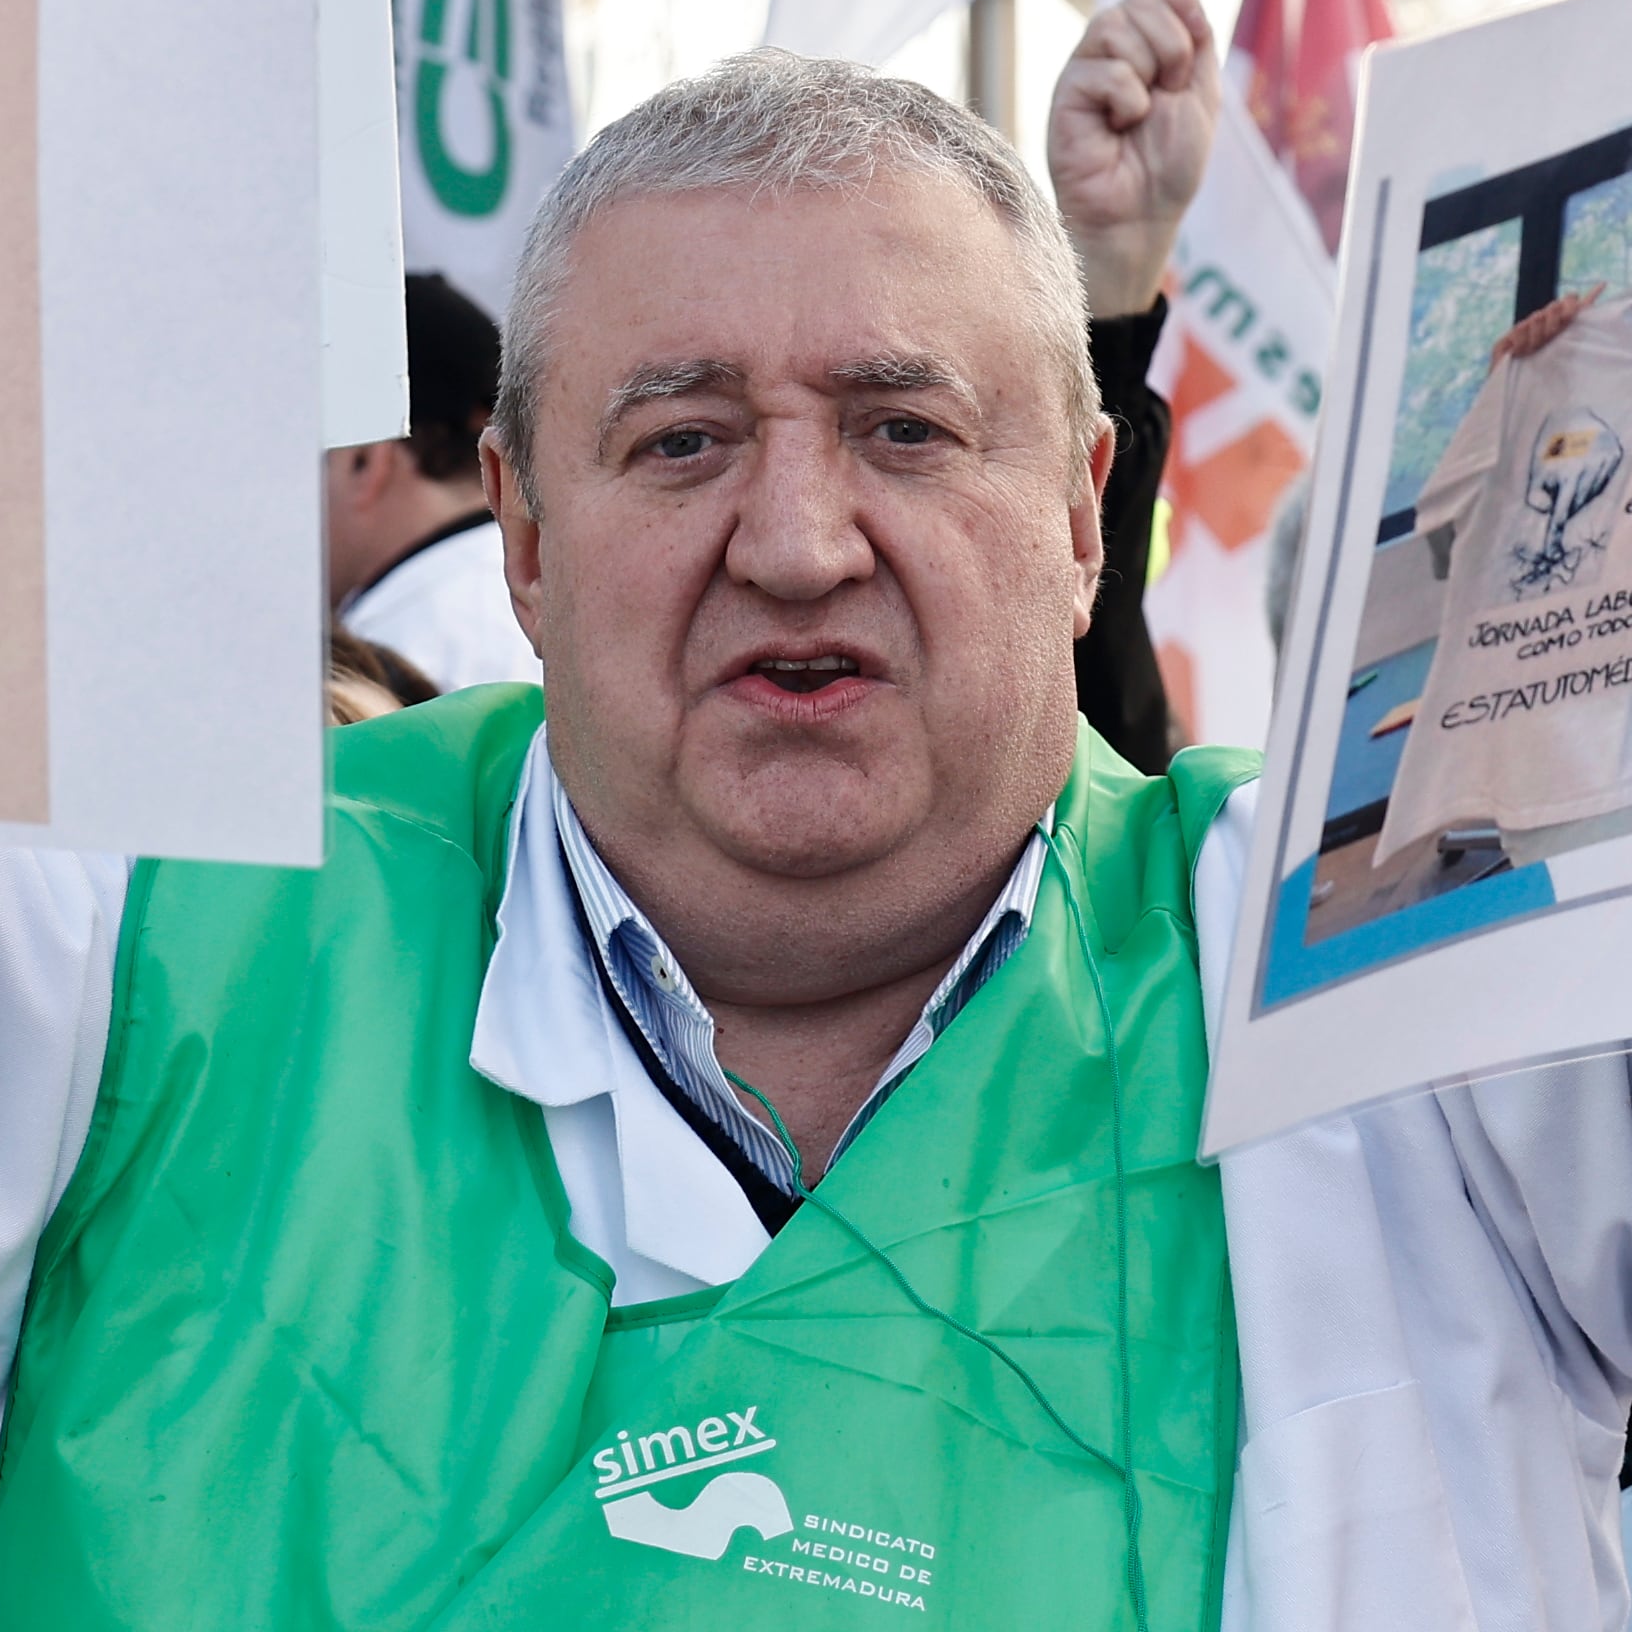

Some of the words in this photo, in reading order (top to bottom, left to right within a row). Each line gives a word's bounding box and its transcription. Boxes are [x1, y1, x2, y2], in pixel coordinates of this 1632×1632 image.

[1469, 607, 1574, 649] JORNADA
[1517, 629, 1582, 660] COMO
[592, 1404, 767, 1485] simex
[803, 1514, 936, 1560] SINDICATO
[743, 1555, 926, 1612] EXTREMADURA
[792, 1537, 889, 1574] MEDICO
[899, 1563, 933, 1585] DE
